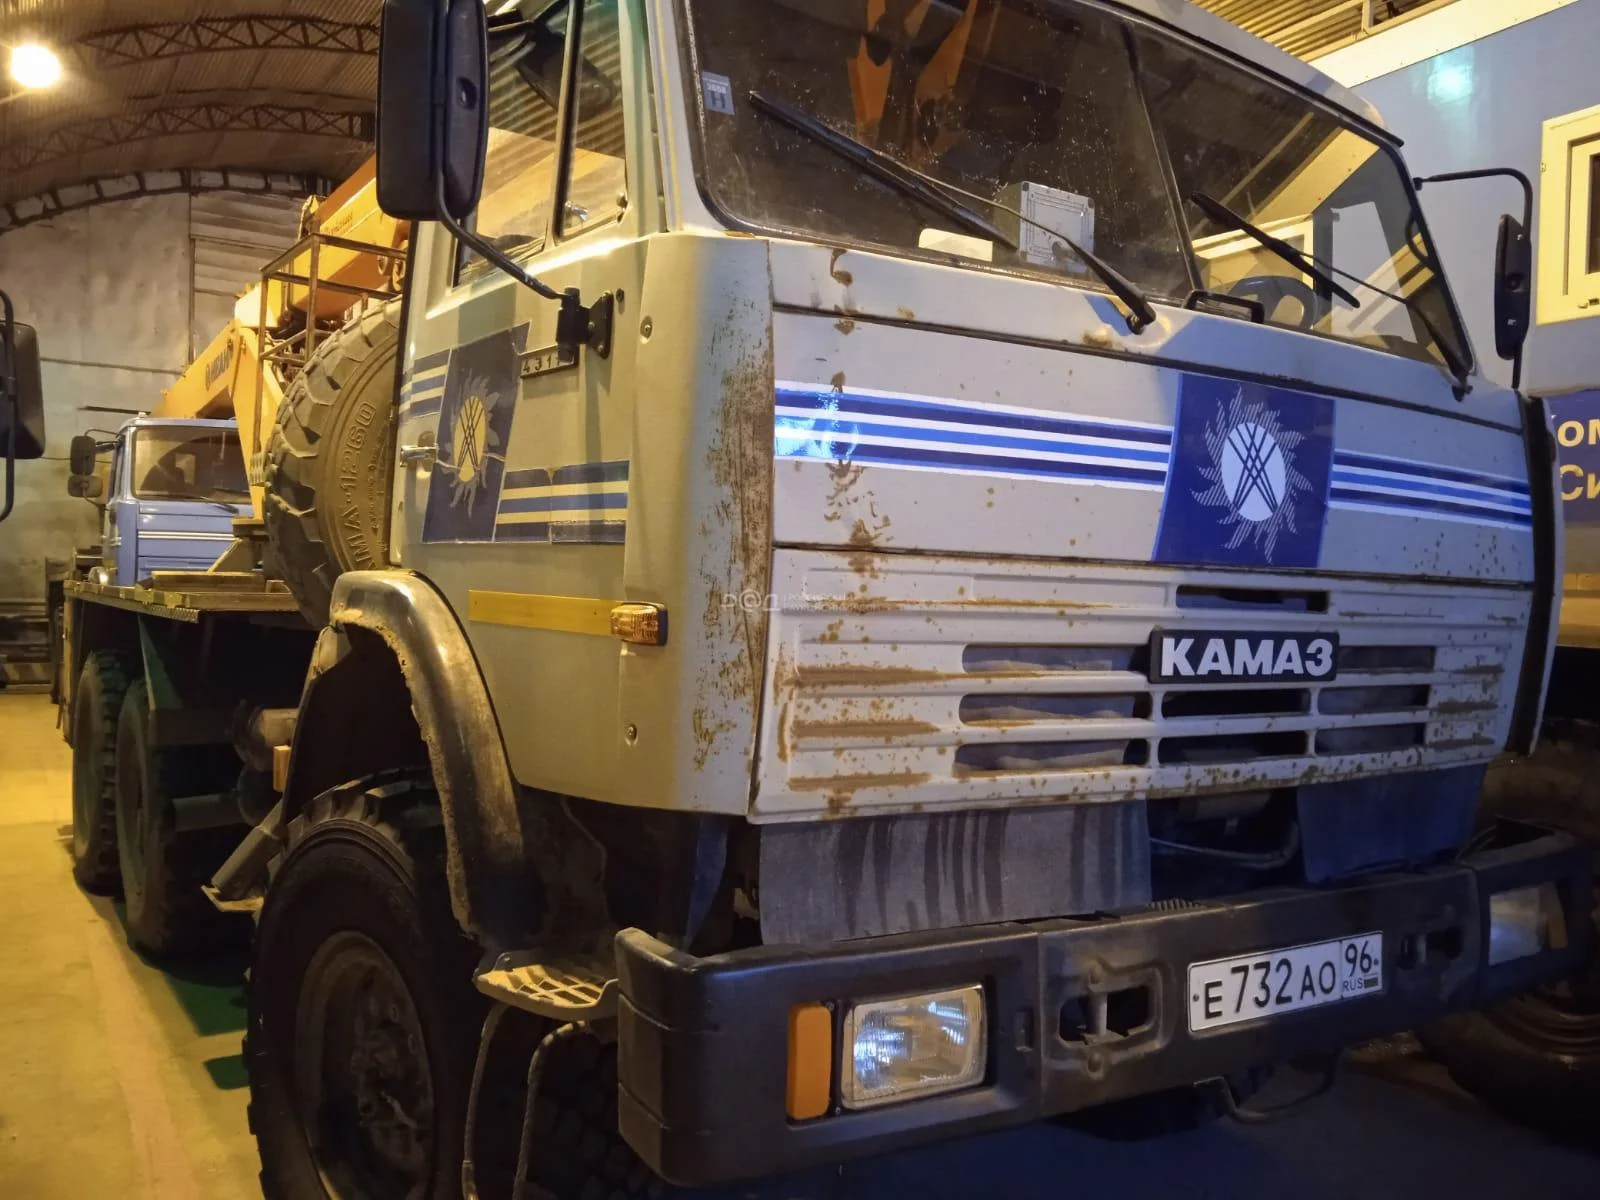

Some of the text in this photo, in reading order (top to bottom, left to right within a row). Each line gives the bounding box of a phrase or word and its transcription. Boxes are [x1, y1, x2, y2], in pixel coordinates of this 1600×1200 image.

[1161, 637, 1332, 677] КАМАЗ
[1344, 940, 1373, 977] 96
[1343, 976, 1364, 991] RUS
